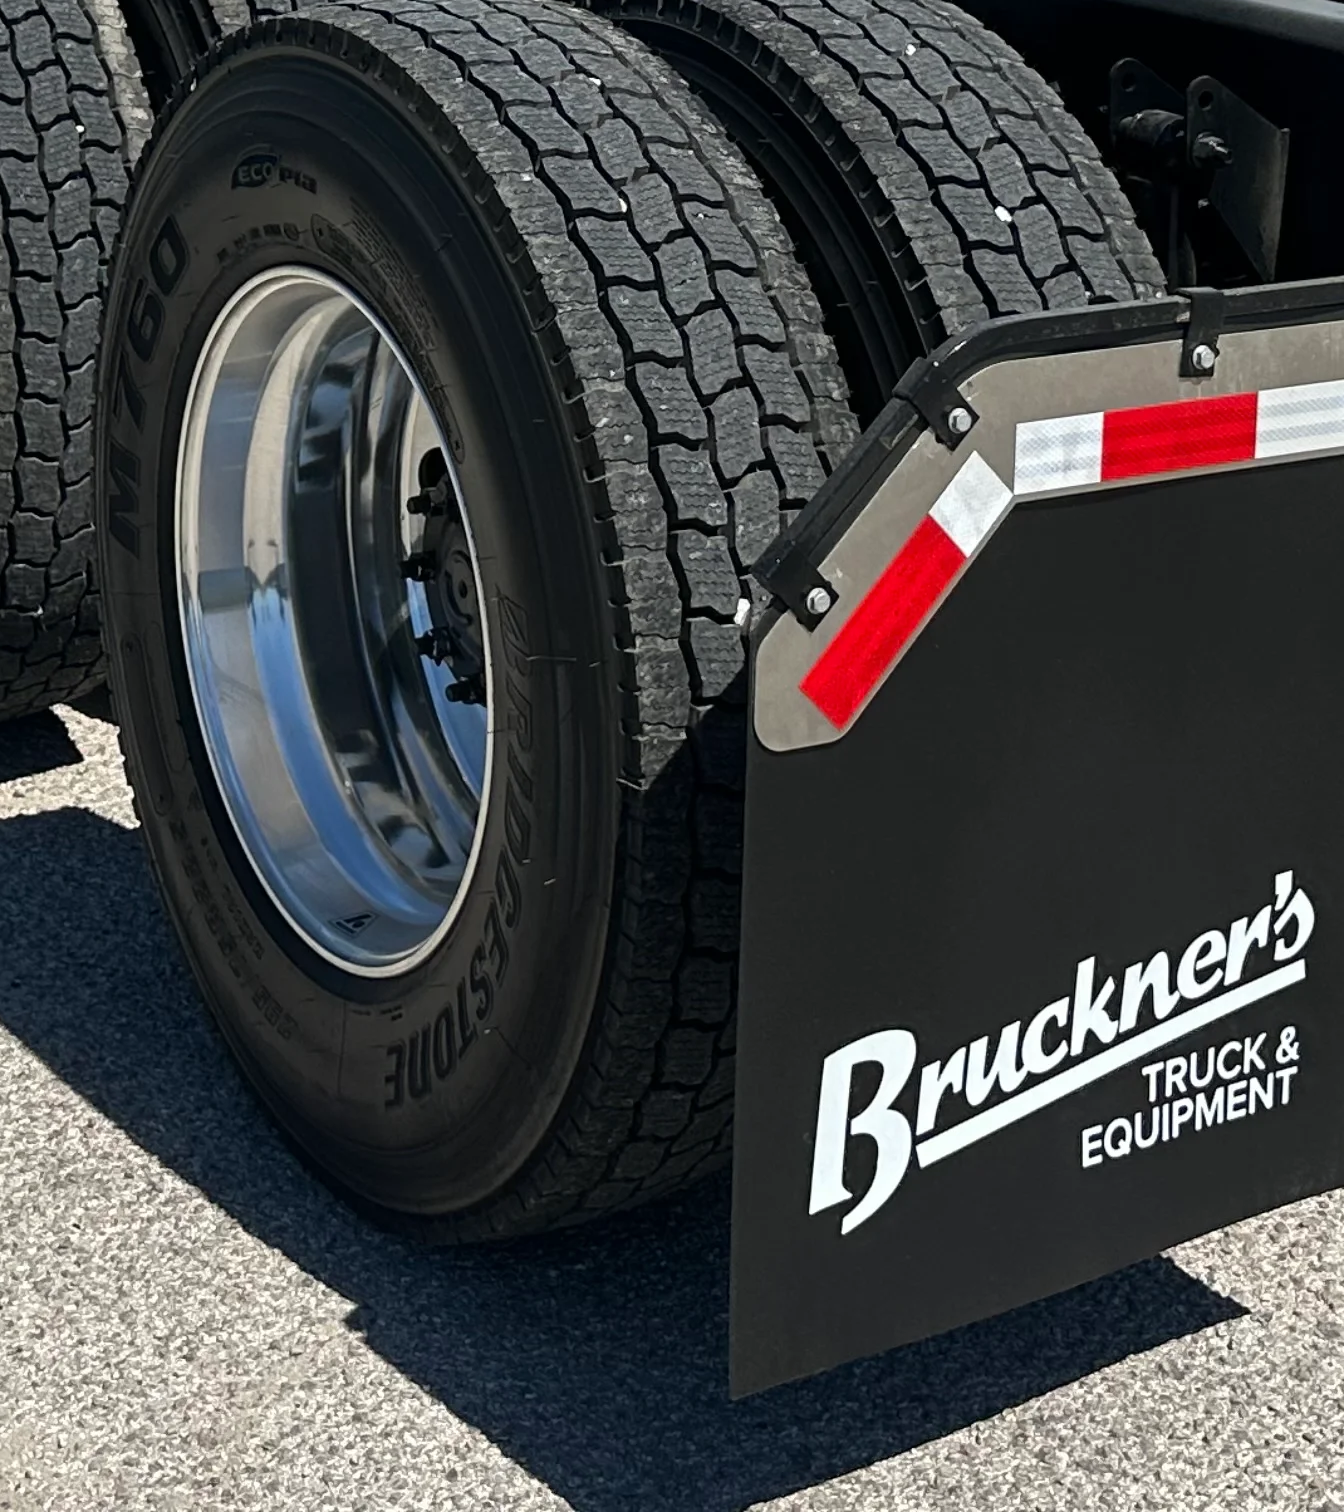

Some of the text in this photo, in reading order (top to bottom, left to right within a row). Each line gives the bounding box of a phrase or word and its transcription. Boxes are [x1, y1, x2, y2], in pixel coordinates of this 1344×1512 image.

[108, 213, 190, 560] M760
[384, 588, 535, 1112] BRIDGESTONE
[809, 869, 1315, 1236] Bruckner's
[1081, 1065, 1299, 1169] EQUIPMENT
[1141, 1025, 1301, 1104] TRUCK &
